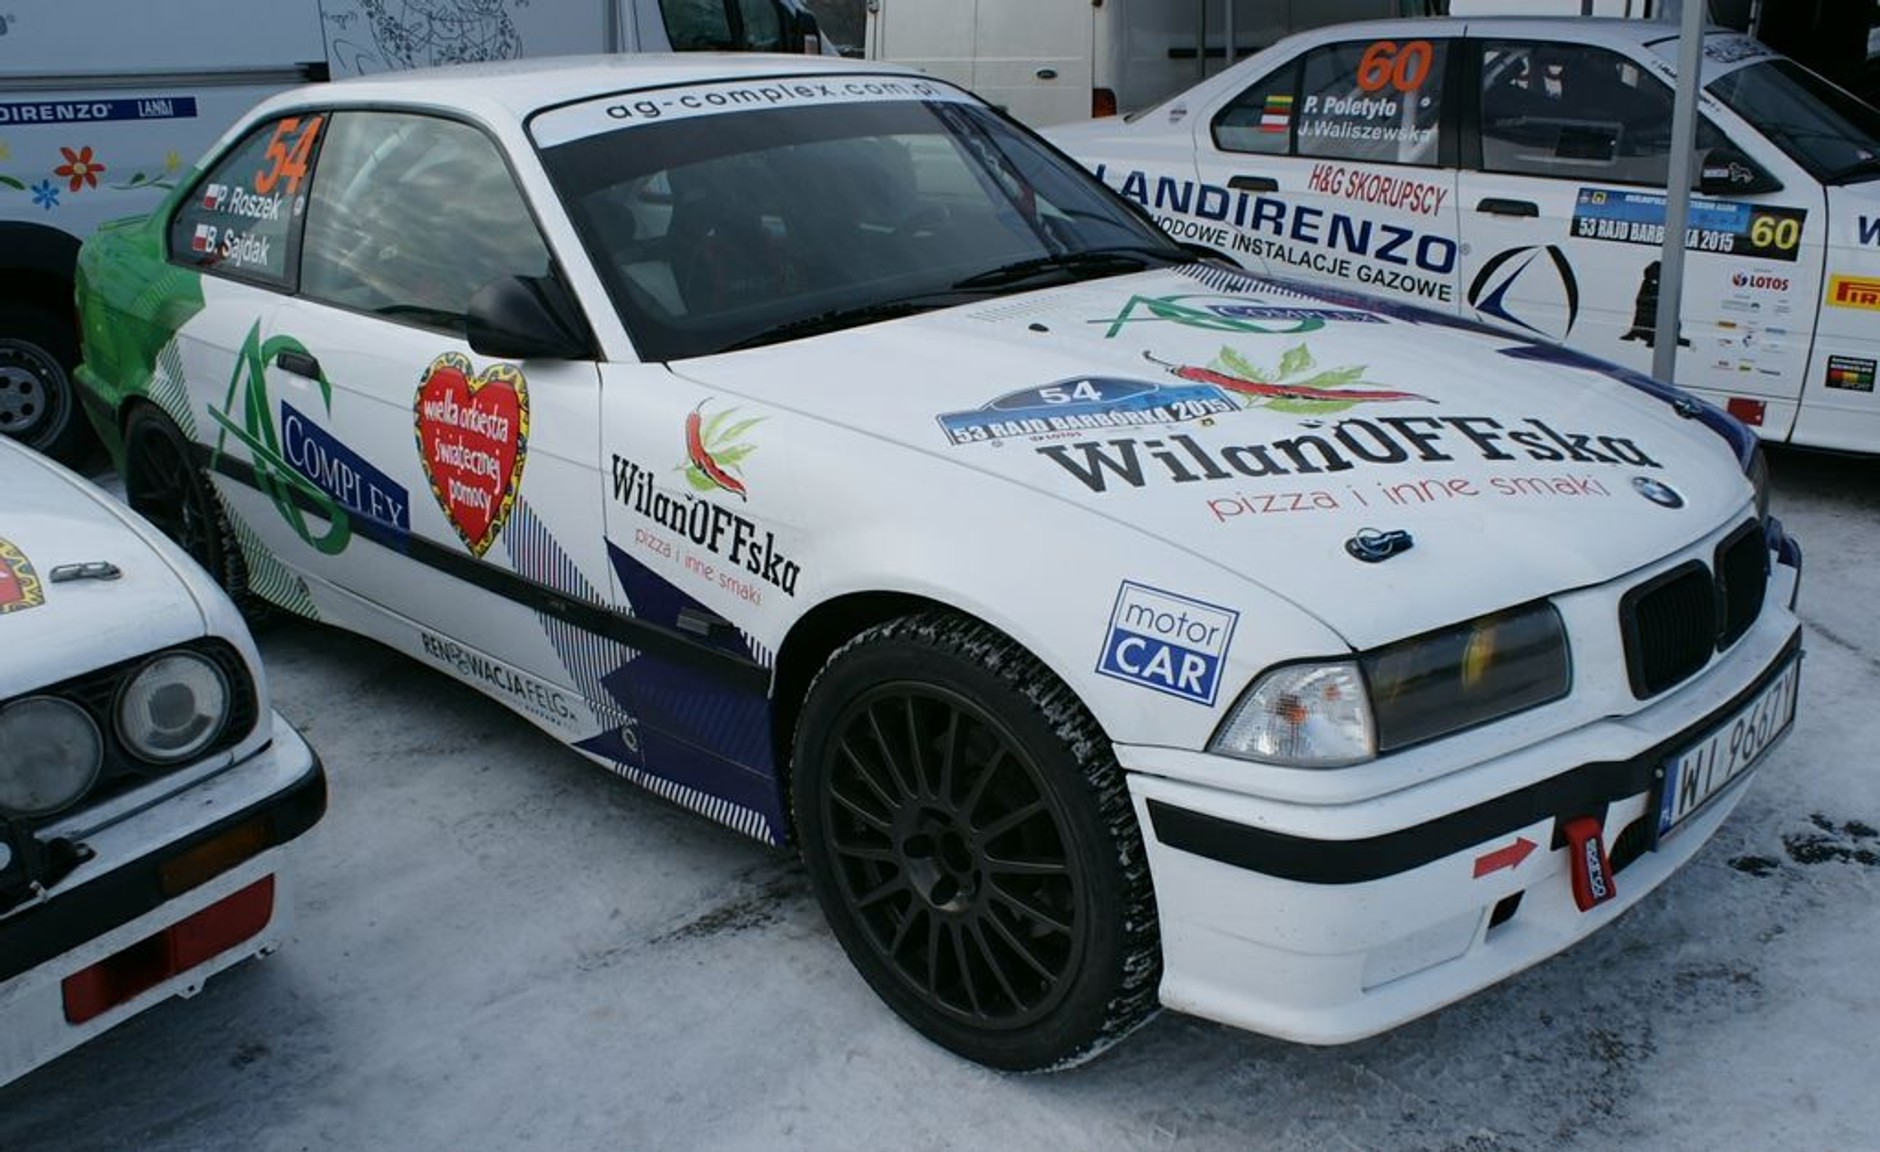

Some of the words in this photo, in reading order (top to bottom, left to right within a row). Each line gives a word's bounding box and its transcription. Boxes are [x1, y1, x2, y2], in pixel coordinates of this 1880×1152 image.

[1357, 41, 1434, 92] 60
[606, 80, 941, 119] ag-complex.com.pl
[1304, 96, 1317, 114] P.
[255, 114, 325, 194] 54
[214, 185, 226, 211] P.
[228, 187, 281, 221] Roszek
[1308, 163, 1346, 195] H&G
[1345, 170, 1448, 216] SKORUPSCY
[206, 226, 218, 255] B.
[222, 228, 270, 268] Sajdak
[1579, 217, 1595, 237] 53
[1597, 220, 1628, 240] RAJD
[1700, 229, 1735, 252] 2015
[1751, 215, 1799, 250] 60
[1231, 233, 1352, 278] INSTALACJE
[1356, 264, 1453, 302] GAZOWE
[1749, 275, 1789, 292] LOTOS
[1039, 380, 1102, 404] 54
[952, 425, 989, 443] 53
[991, 416, 1047, 439] RAJD
[1053, 410, 1170, 433] BARBÓRKA
[1171, 398, 1231, 422] 2015
[1207, 490, 1340, 523] pizza
[1347, 484, 1367, 507] i
[1376, 476, 1480, 505] inne
[1490, 473, 1611, 498] smaki
[635, 528, 671, 559] pizza
[685, 553, 714, 582] inne
[719, 572, 762, 606] smaki
[1125, 603, 1220, 647] motor
[1115, 636, 1203, 694] CAR
[1678, 737, 1718, 815] WI
